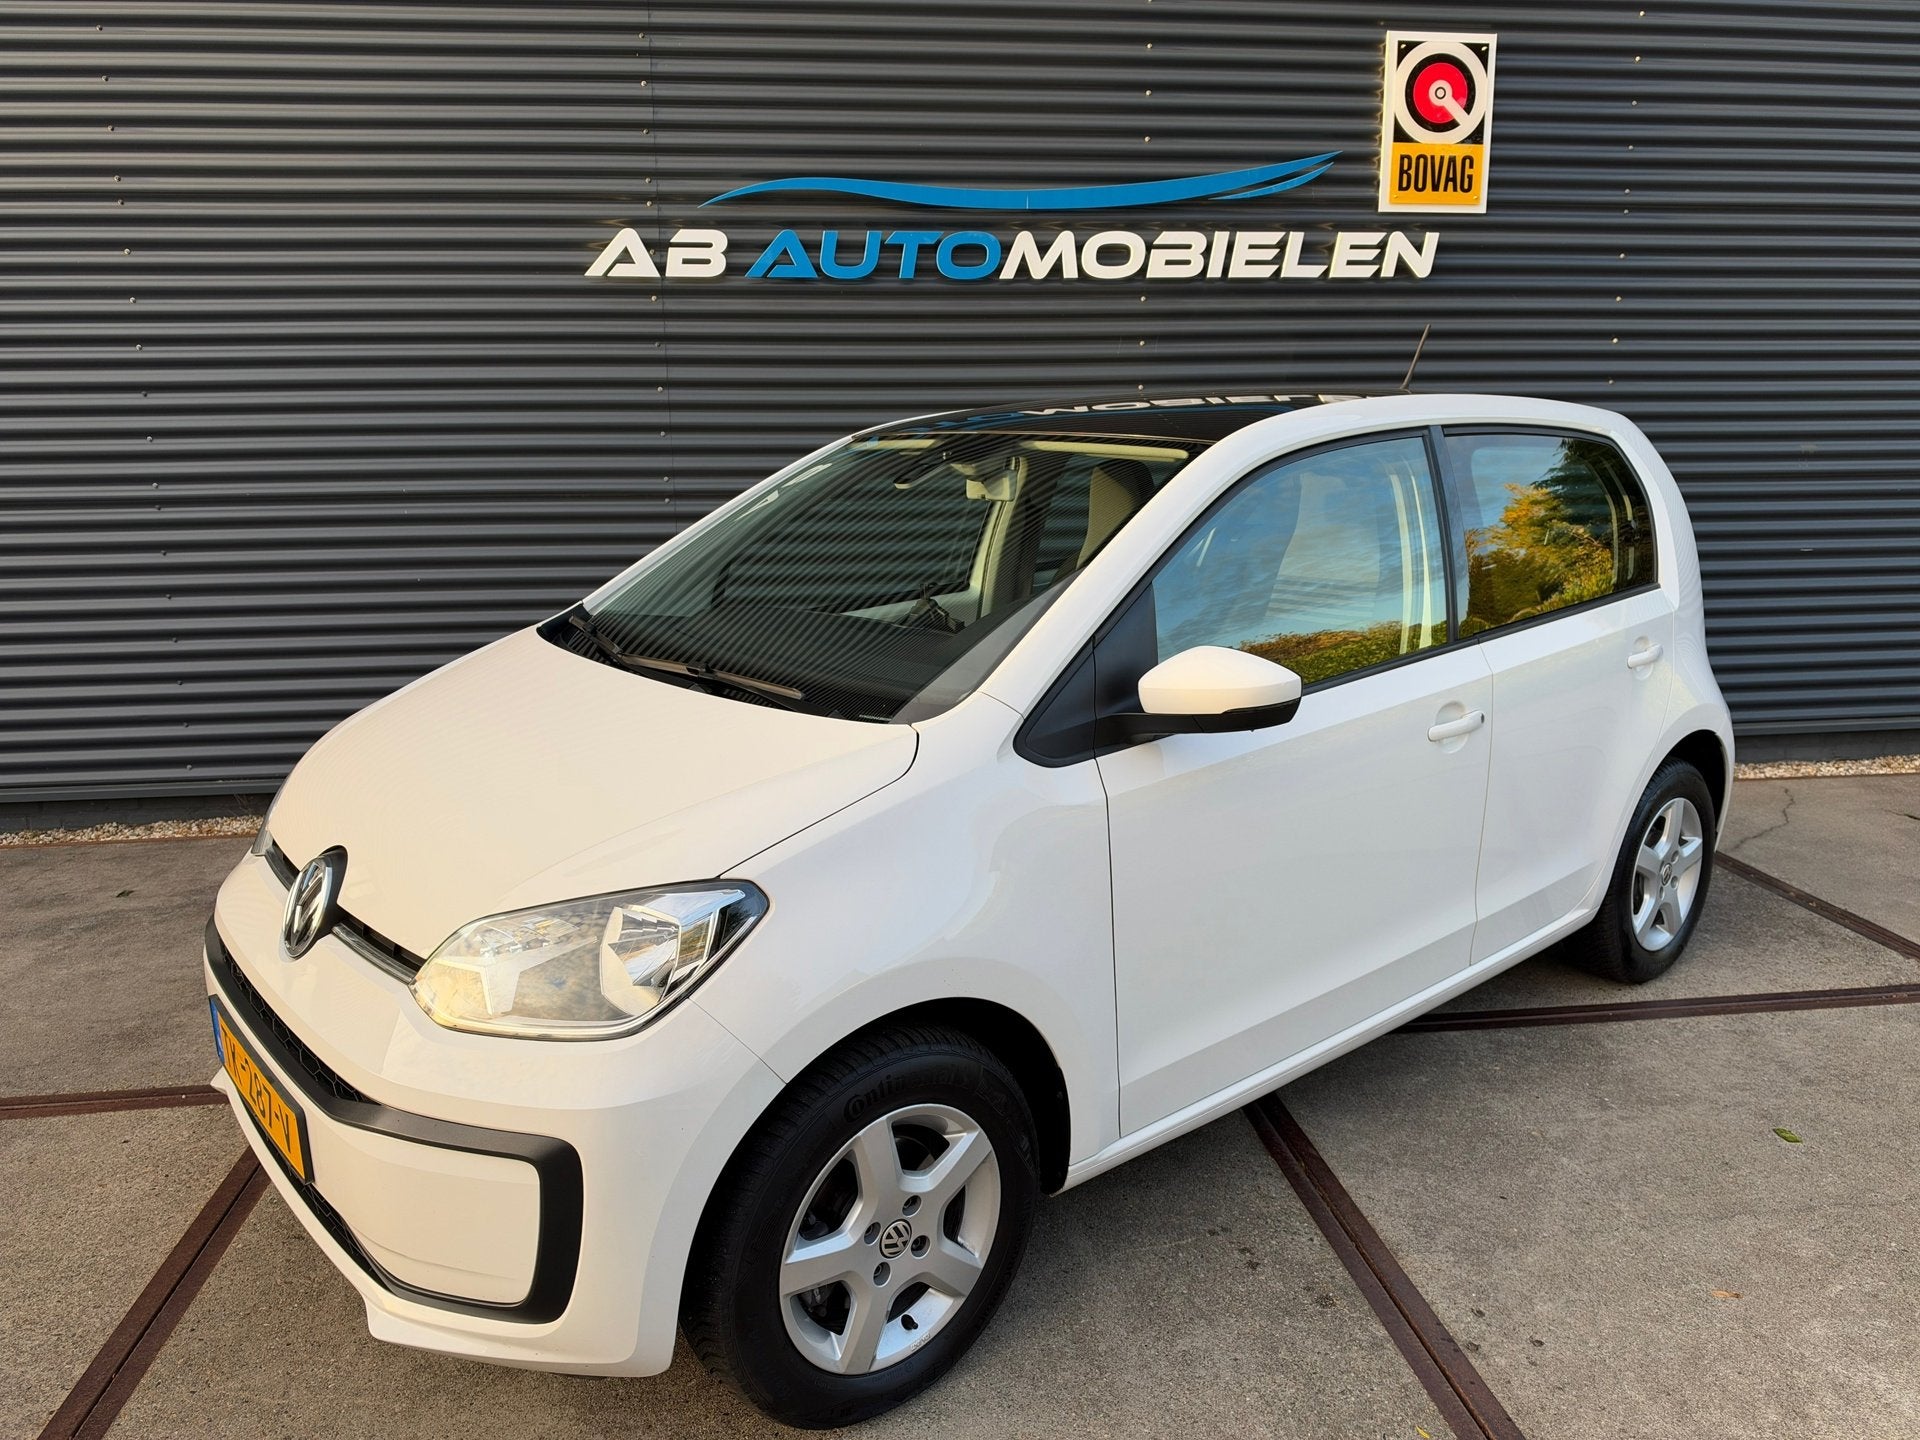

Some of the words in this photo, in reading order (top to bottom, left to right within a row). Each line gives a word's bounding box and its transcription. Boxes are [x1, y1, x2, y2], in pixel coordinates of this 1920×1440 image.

[1397, 153, 1475, 194] BOVAG
[584, 228, 728, 278] AB
[744, 229, 1440, 280] AUTOMOBIELEN
[220, 1022, 292, 1154] TK-287-V
